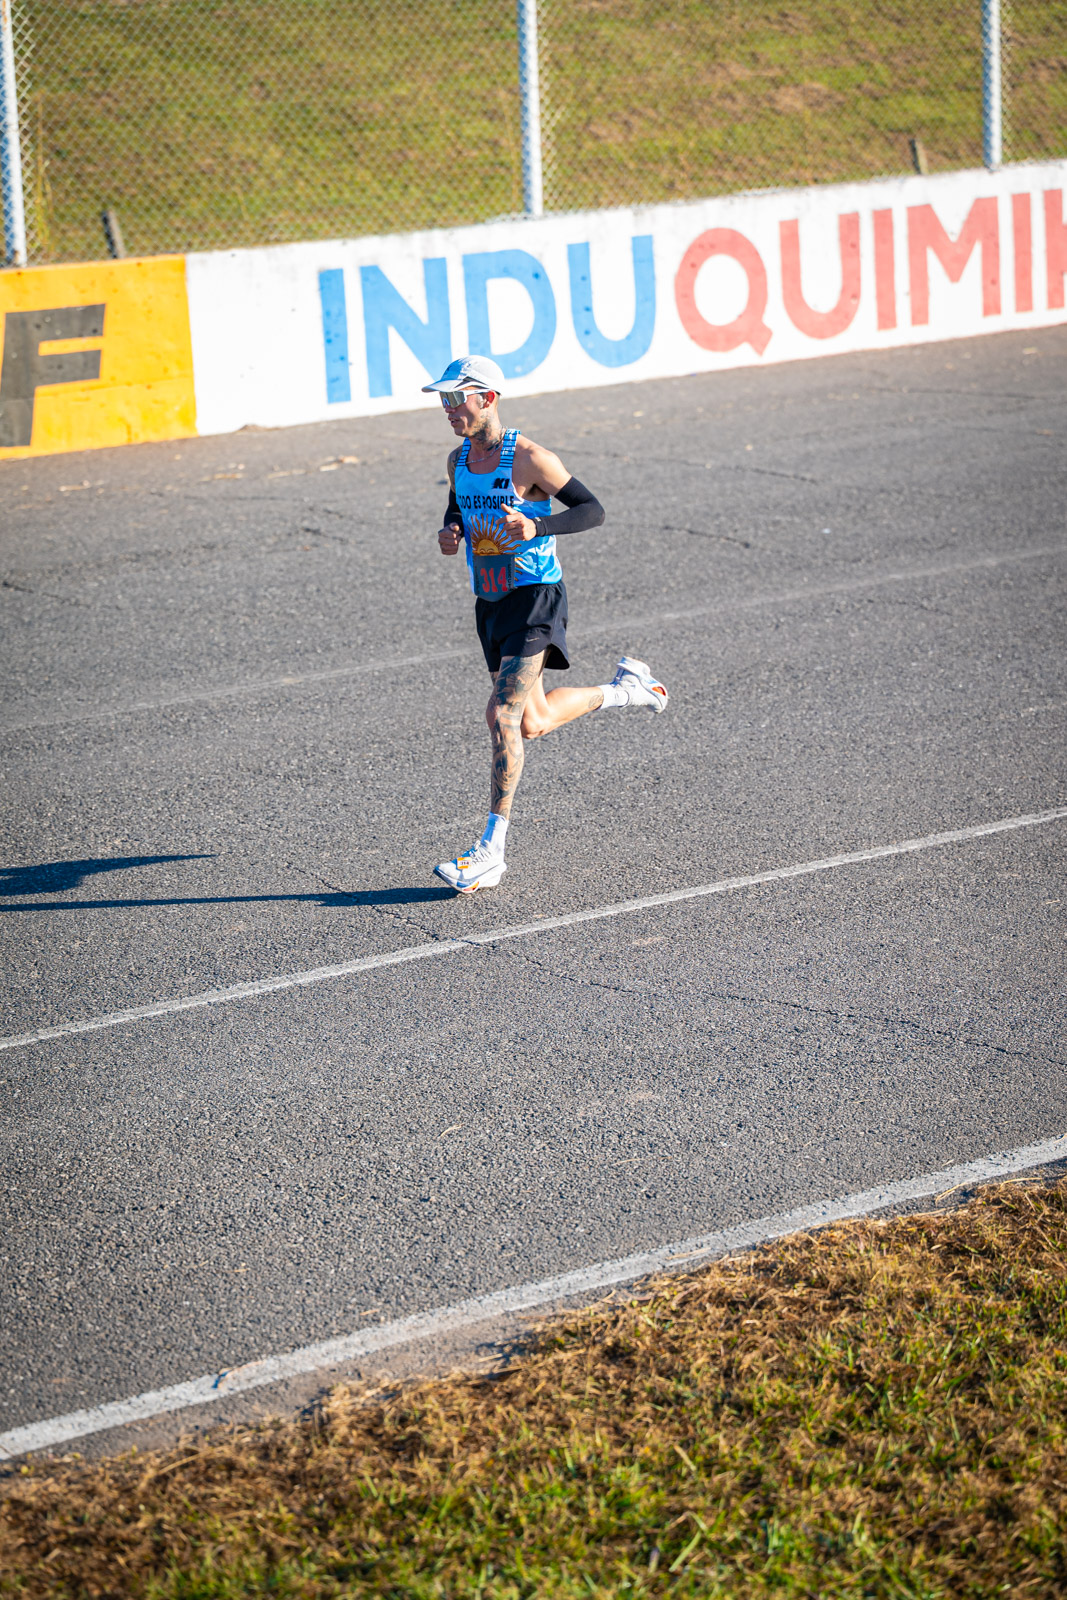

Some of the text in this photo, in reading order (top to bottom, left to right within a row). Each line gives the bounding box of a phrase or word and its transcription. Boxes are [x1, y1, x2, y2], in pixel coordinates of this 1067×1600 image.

[0, 304, 106, 447] F
[474, 495, 481, 509] ES
[481, 567, 508, 593] 314
